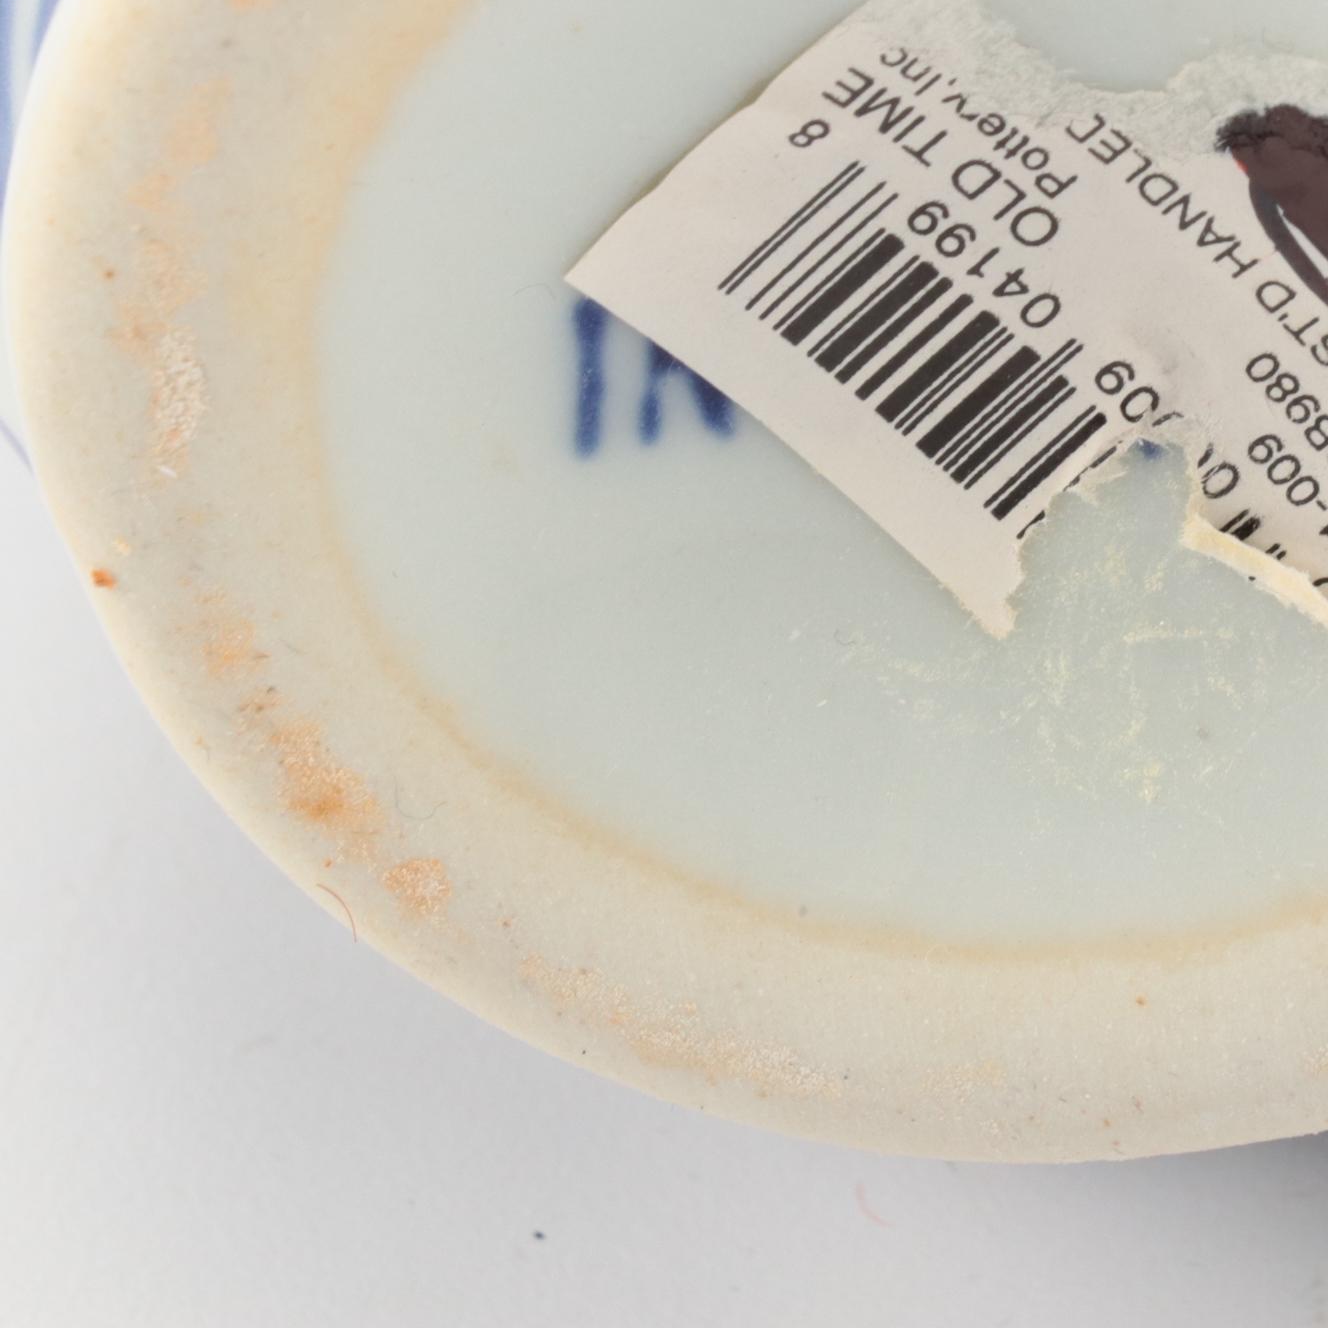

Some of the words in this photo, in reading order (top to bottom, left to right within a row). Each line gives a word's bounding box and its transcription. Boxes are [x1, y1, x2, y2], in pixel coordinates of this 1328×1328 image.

[787, 118, 832, 148] 8
[821, 66, 948, 168] TIME
[950, 158, 1060, 248] OLD
[906, 199, 1062, 329] 04199
